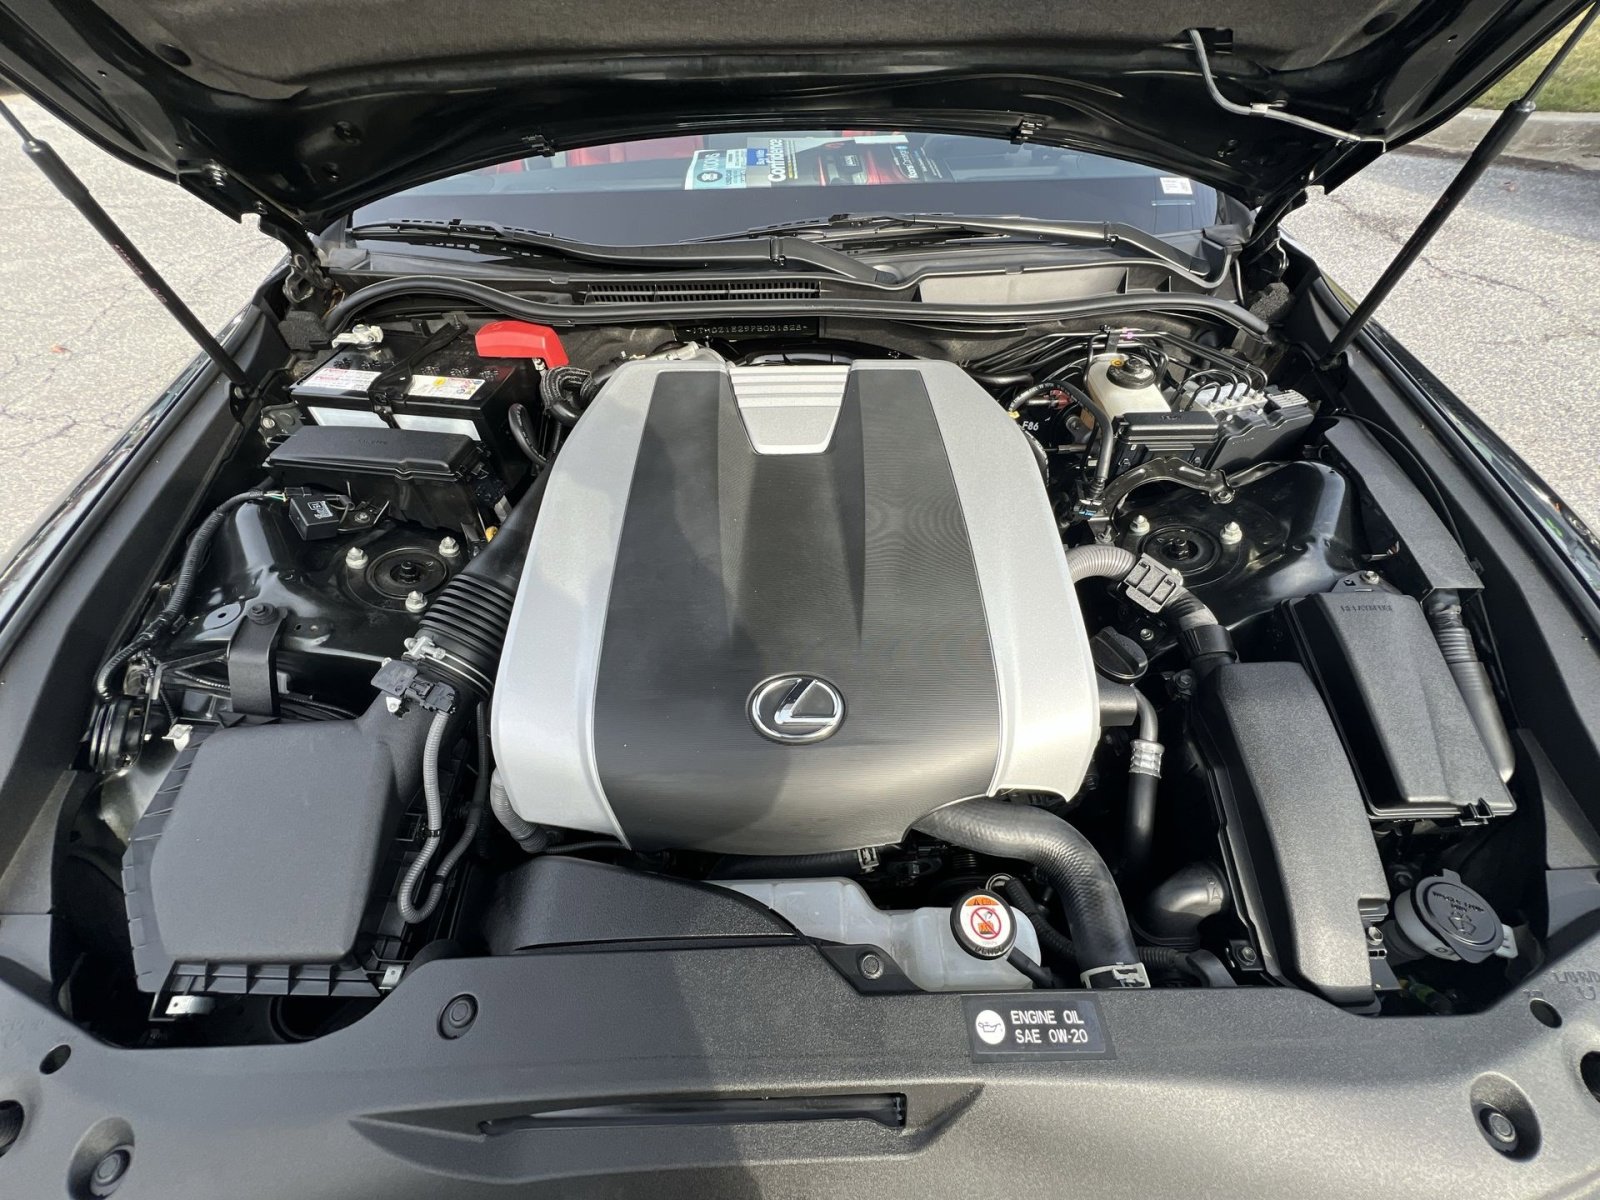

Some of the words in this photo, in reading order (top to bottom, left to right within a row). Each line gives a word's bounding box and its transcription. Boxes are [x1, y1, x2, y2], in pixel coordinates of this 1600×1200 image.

[766, 138, 786, 182] Confidence
[1010, 1010, 1057, 1025] ENGINE
[1063, 1010, 1084, 1024] OIL
[1015, 1029, 1042, 1043] SAE
[1048, 1029, 1088, 1043] 0W-20
